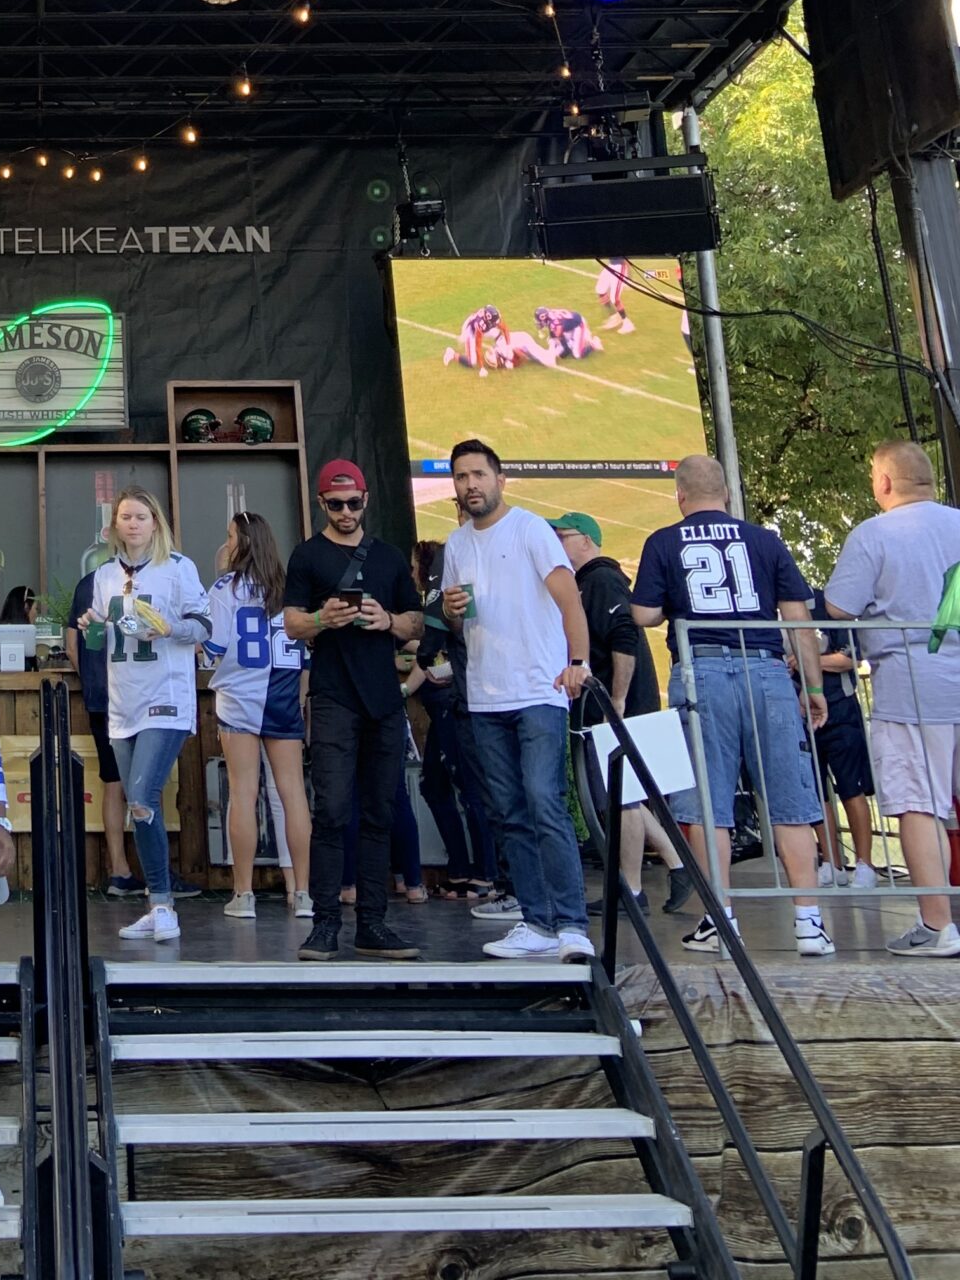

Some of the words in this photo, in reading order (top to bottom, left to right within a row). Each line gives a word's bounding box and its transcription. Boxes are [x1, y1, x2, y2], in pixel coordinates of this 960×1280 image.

[680, 523, 741, 541] ELLIOTT
[680, 542, 760, 613] 21
[108, 594, 158, 663] 11
[236, 606, 301, 669] 82
